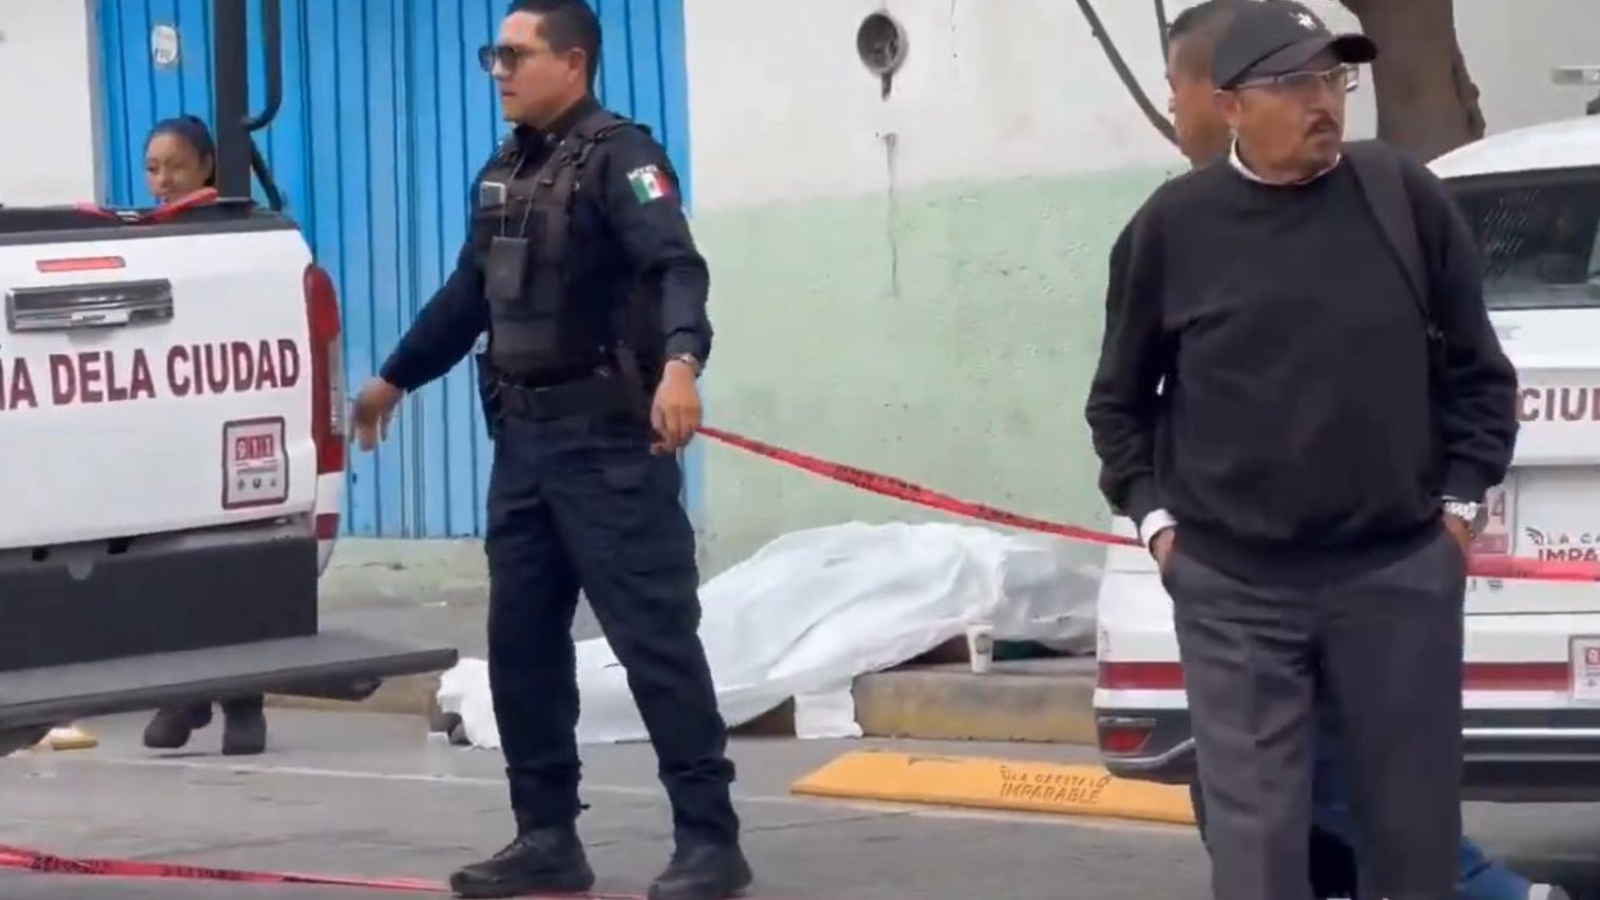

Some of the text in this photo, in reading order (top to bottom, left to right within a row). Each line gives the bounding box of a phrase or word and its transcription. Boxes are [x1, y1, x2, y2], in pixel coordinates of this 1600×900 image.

[50, 349, 156, 405] DELA
[167, 339, 299, 396] CIUDAD
[1000, 782, 1100, 803] IMPARABLE
